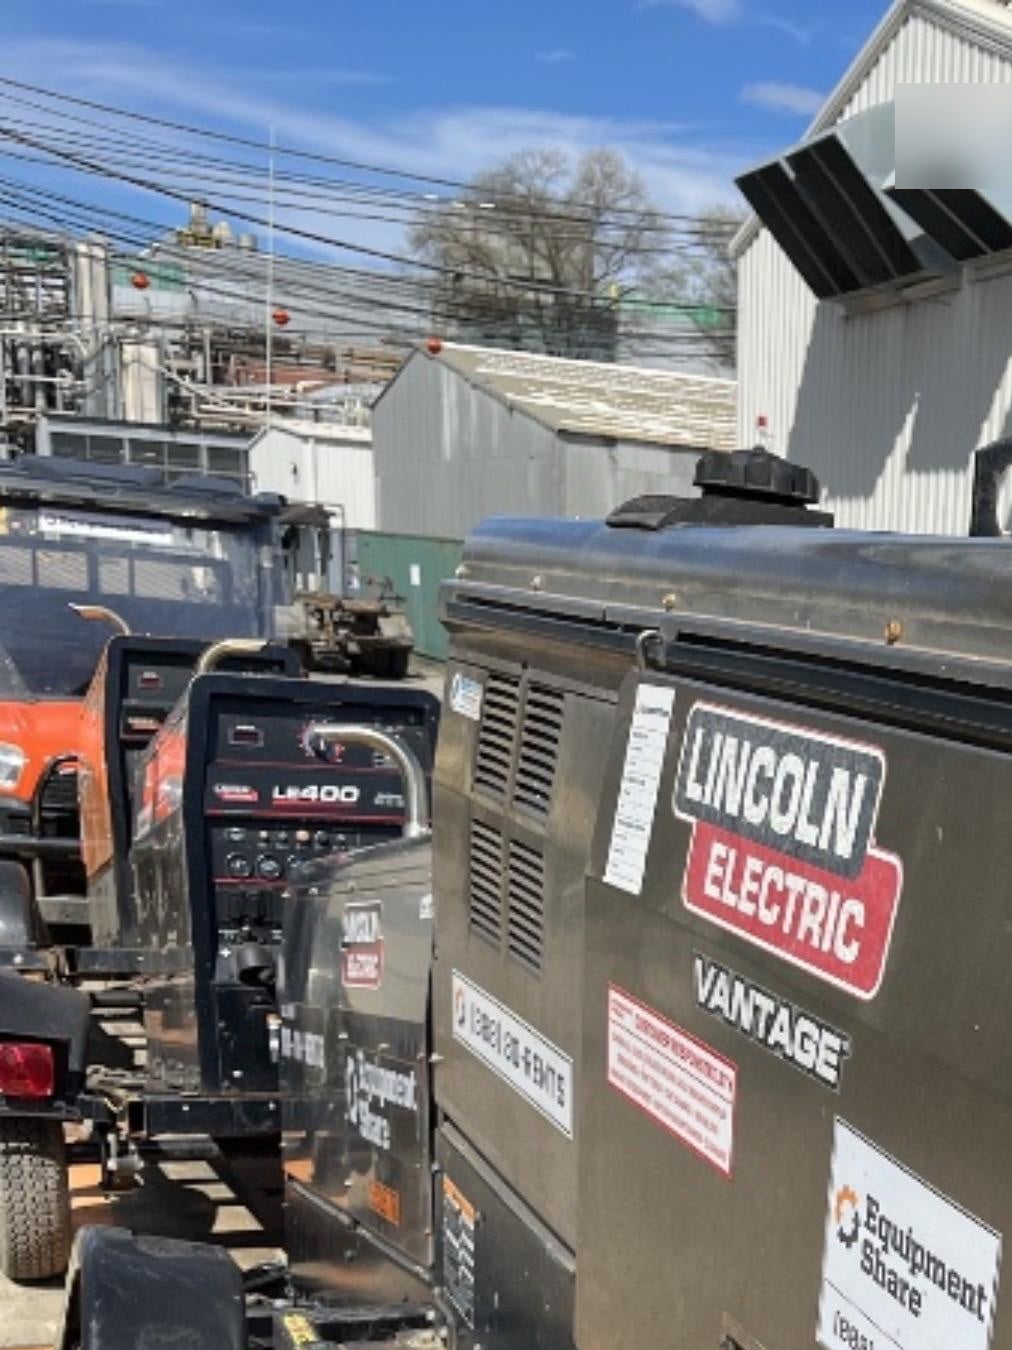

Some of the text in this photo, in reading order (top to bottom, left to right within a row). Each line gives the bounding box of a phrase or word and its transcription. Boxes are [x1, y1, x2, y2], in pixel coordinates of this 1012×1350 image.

[685, 727, 868, 859] LINCOLN
[703, 841, 865, 965] ELECTRIC
[694, 956, 843, 1084] VANTAGE
[860, 1238, 923, 1318] Share
[863, 1193, 988, 1322] Equipment
